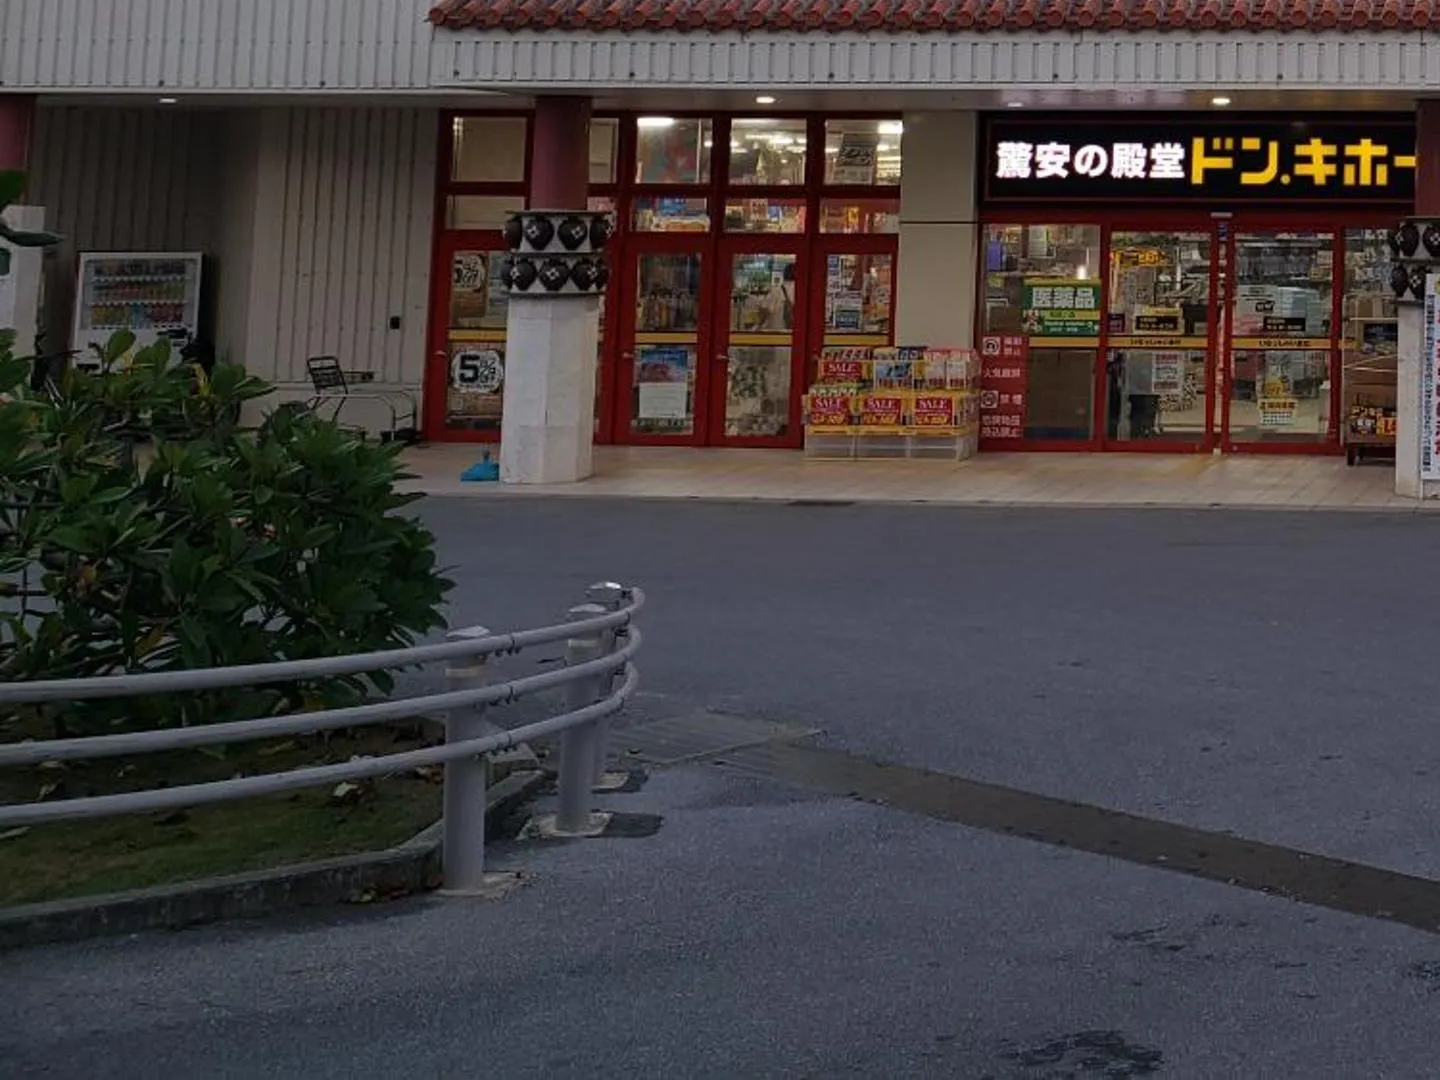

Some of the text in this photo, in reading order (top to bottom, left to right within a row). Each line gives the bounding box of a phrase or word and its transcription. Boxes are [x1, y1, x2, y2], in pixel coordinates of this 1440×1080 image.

[996, 142, 1185, 179] 驚安の殿堂
[828, 363, 857, 373] SALE
[919, 398, 948, 409] SALE
